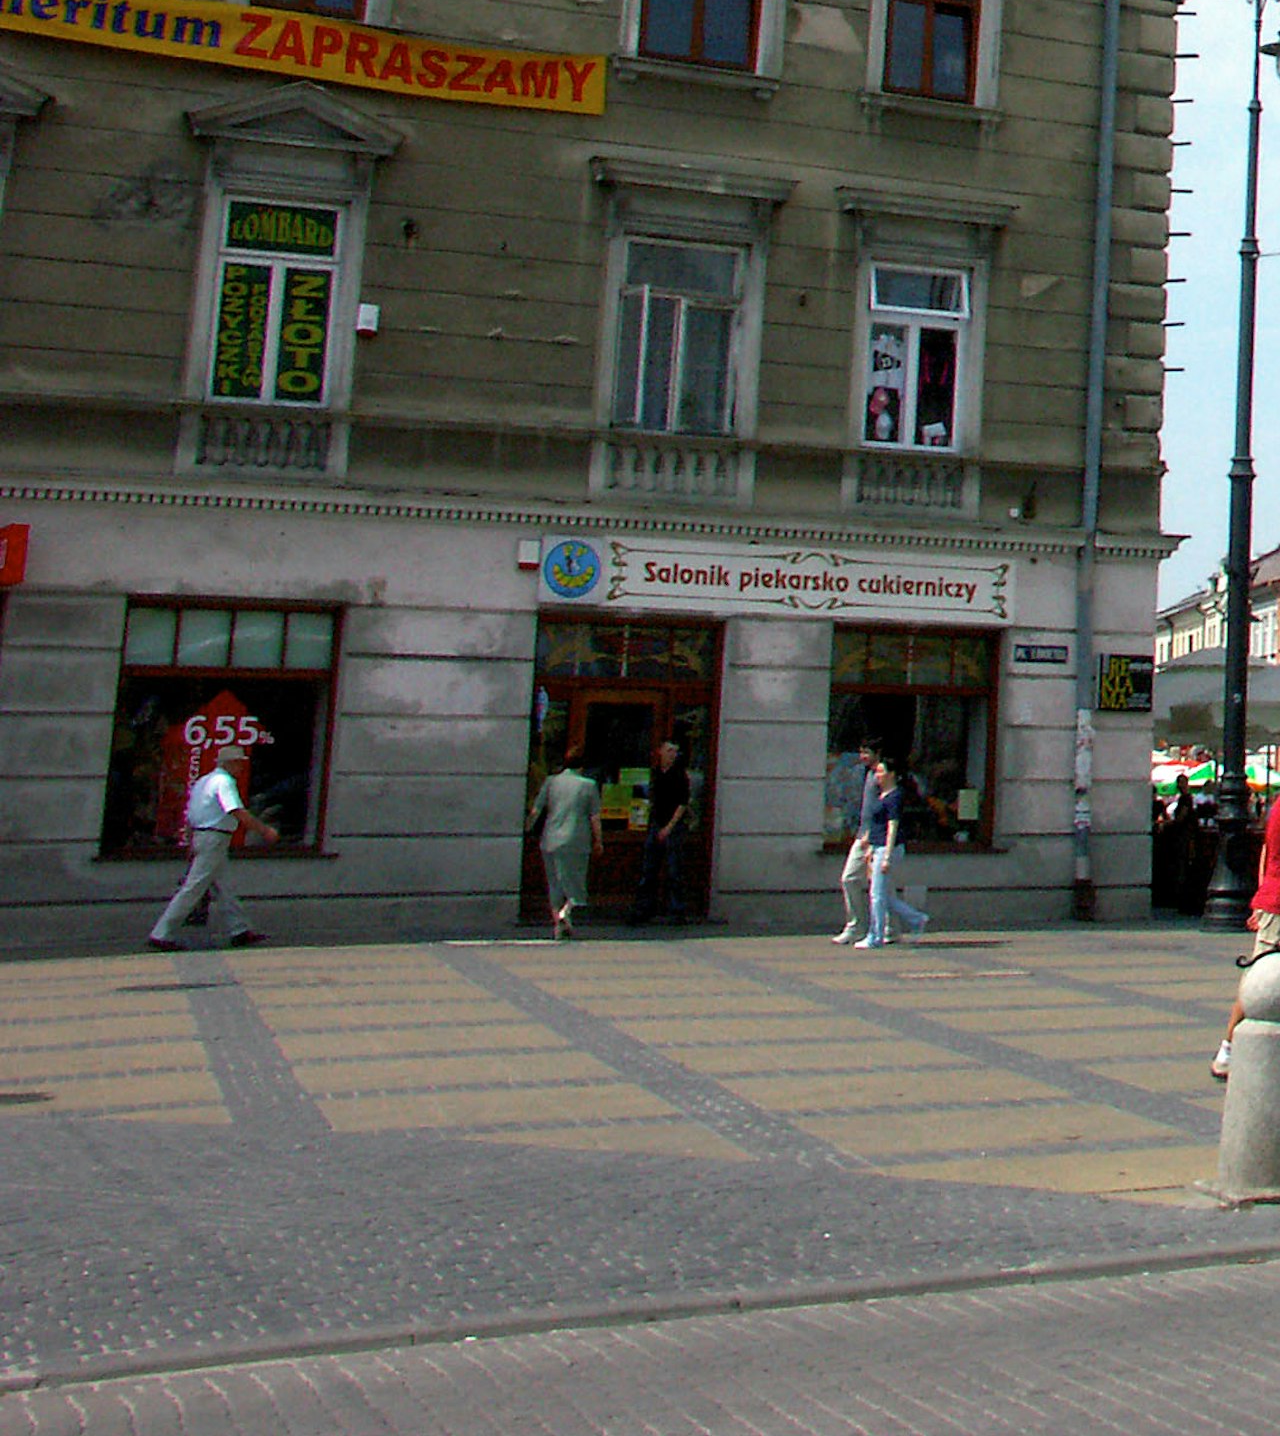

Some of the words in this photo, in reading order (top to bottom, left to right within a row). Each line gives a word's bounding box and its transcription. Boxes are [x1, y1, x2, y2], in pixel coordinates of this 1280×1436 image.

[235, 13, 596, 102] ZAPRASZAMY
[232, 212, 333, 247] LOMBARD
[279, 275, 326, 392] ZŁOTO
[644, 562, 730, 587] Salonik
[739, 566, 849, 593] piekarsko
[857, 575, 977, 604] cukierniczy
[184, 715, 275, 749] 6,55%
